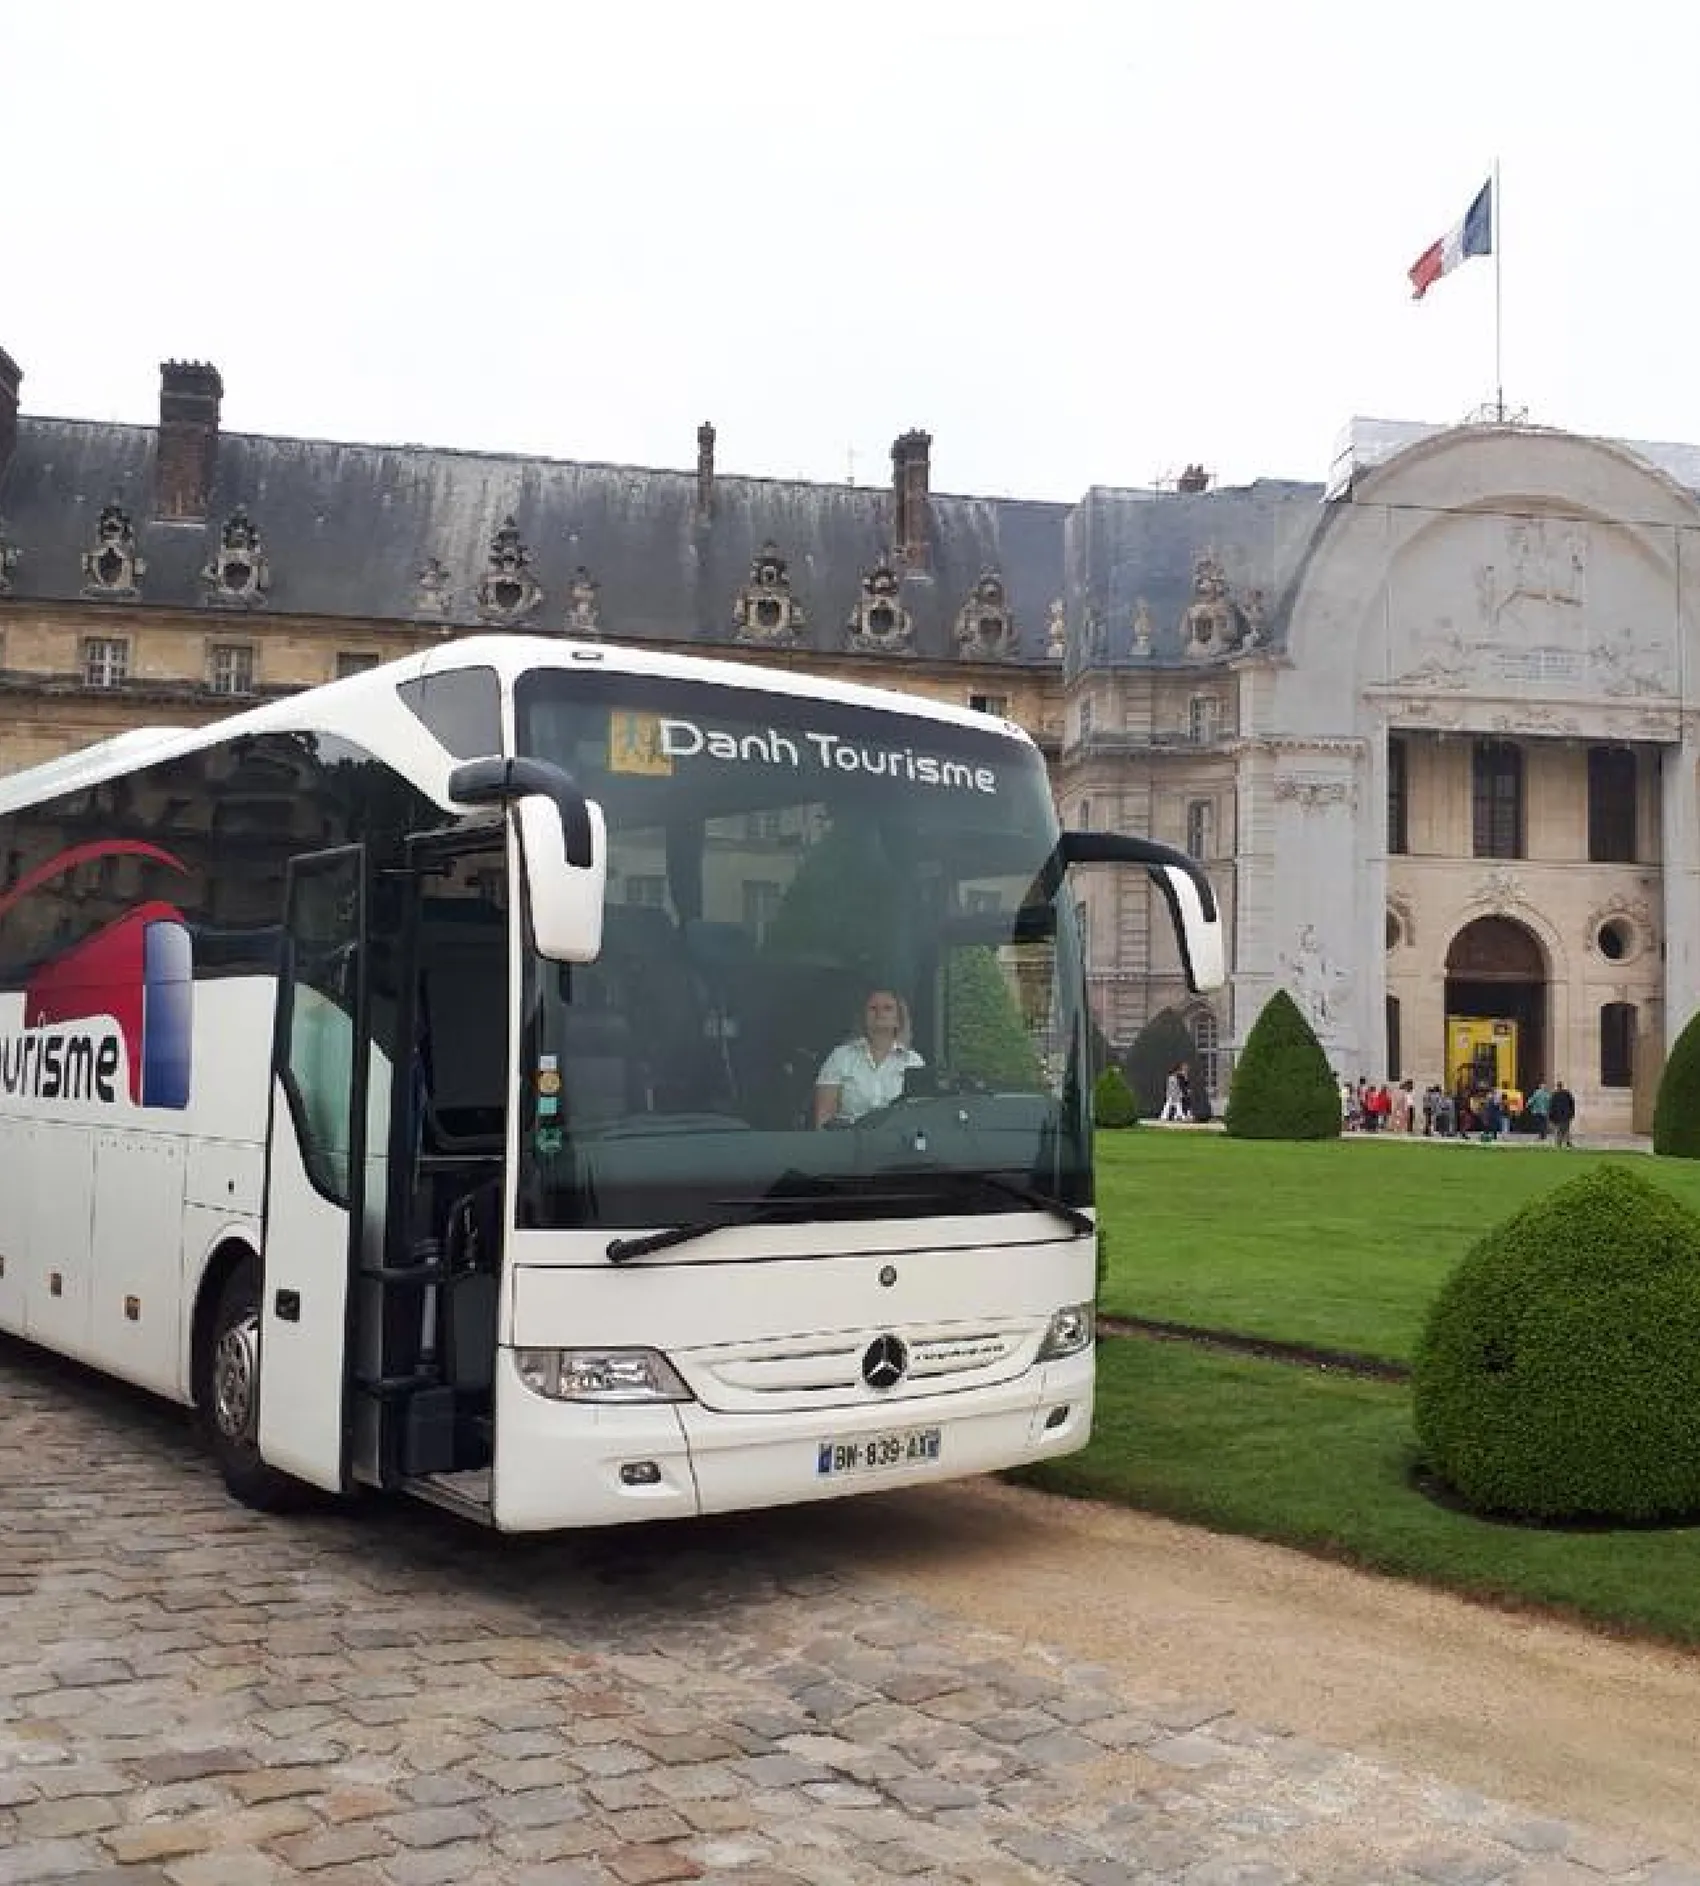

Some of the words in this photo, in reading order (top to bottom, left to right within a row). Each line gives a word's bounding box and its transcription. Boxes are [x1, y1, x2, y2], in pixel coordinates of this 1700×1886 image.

[659, 718, 799, 766] Danh
[805, 732, 998, 794] Tourisme
[0, 1034, 119, 1103] urisme
